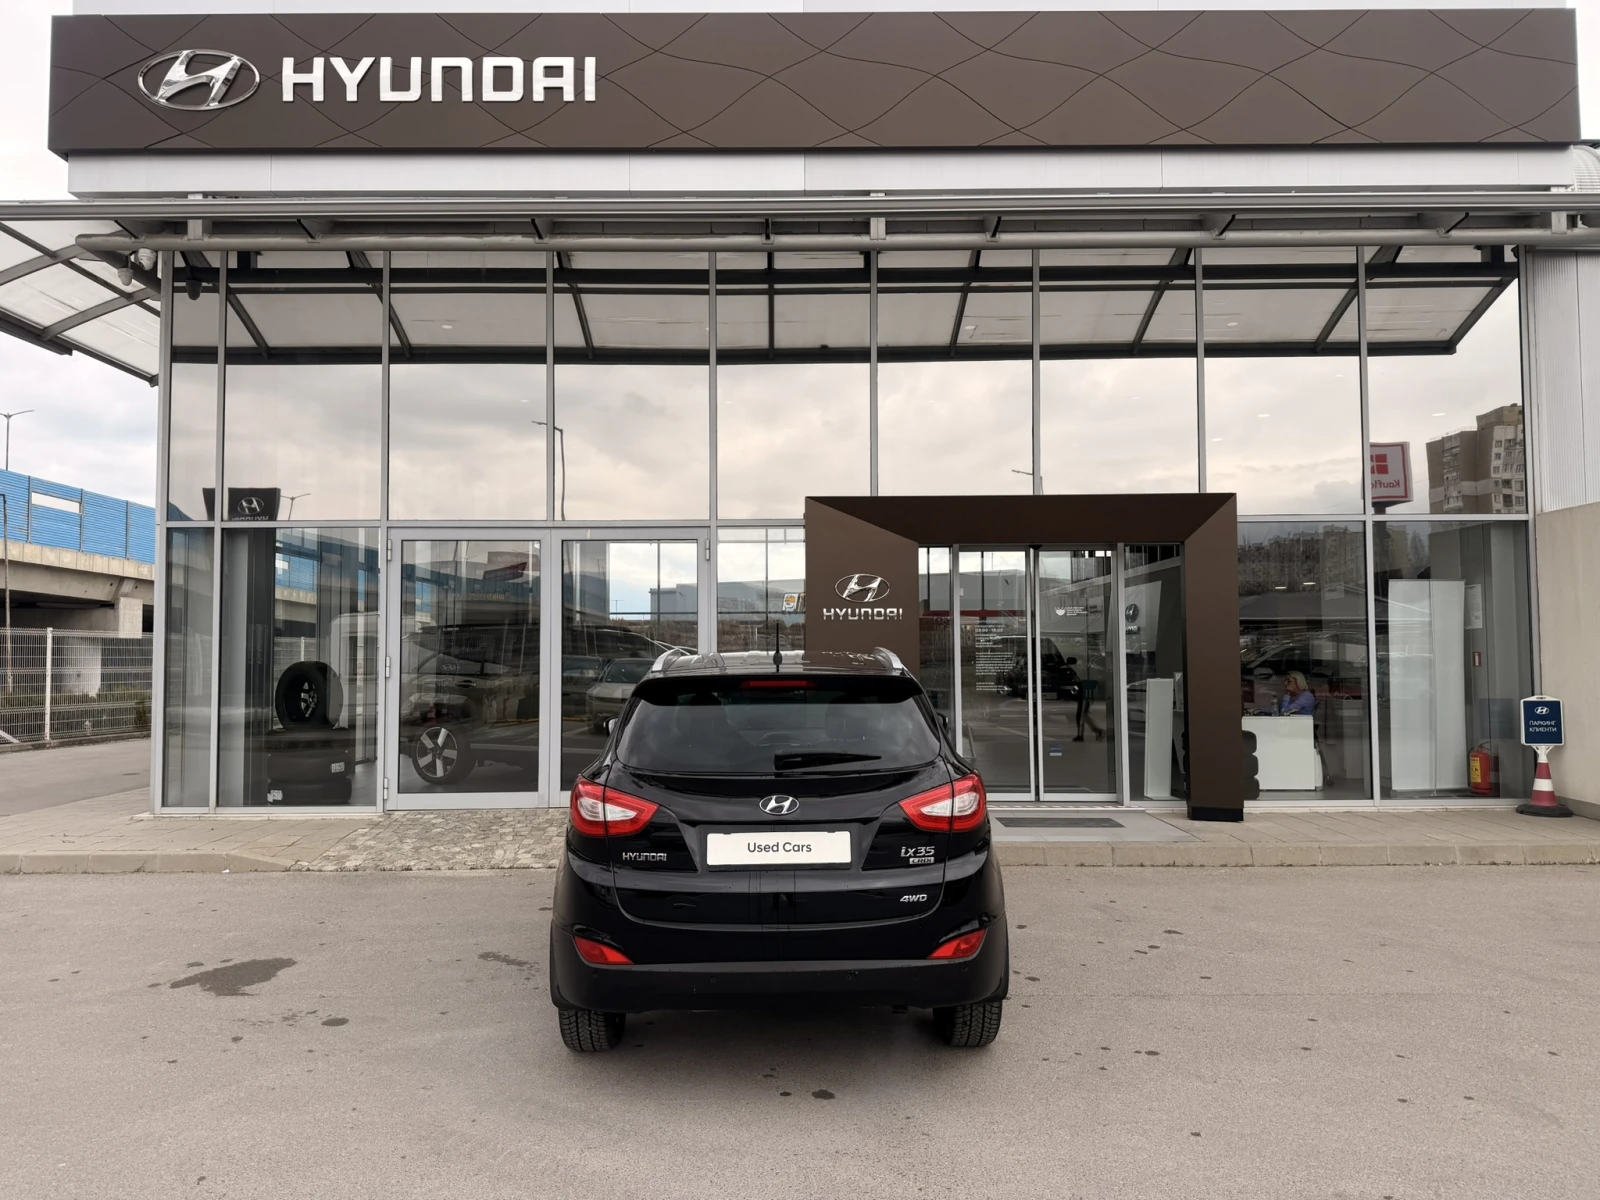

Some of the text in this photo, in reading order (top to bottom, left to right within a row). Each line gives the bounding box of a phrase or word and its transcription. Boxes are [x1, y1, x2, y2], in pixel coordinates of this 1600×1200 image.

[282, 56, 597, 103] HYUNDAI
[822, 608, 903, 621] HYUNDAI
[747, 842, 812, 853] Used Cars
[622, 852, 667, 861] HYUNDAI
[900, 894, 927, 902] 4WD
